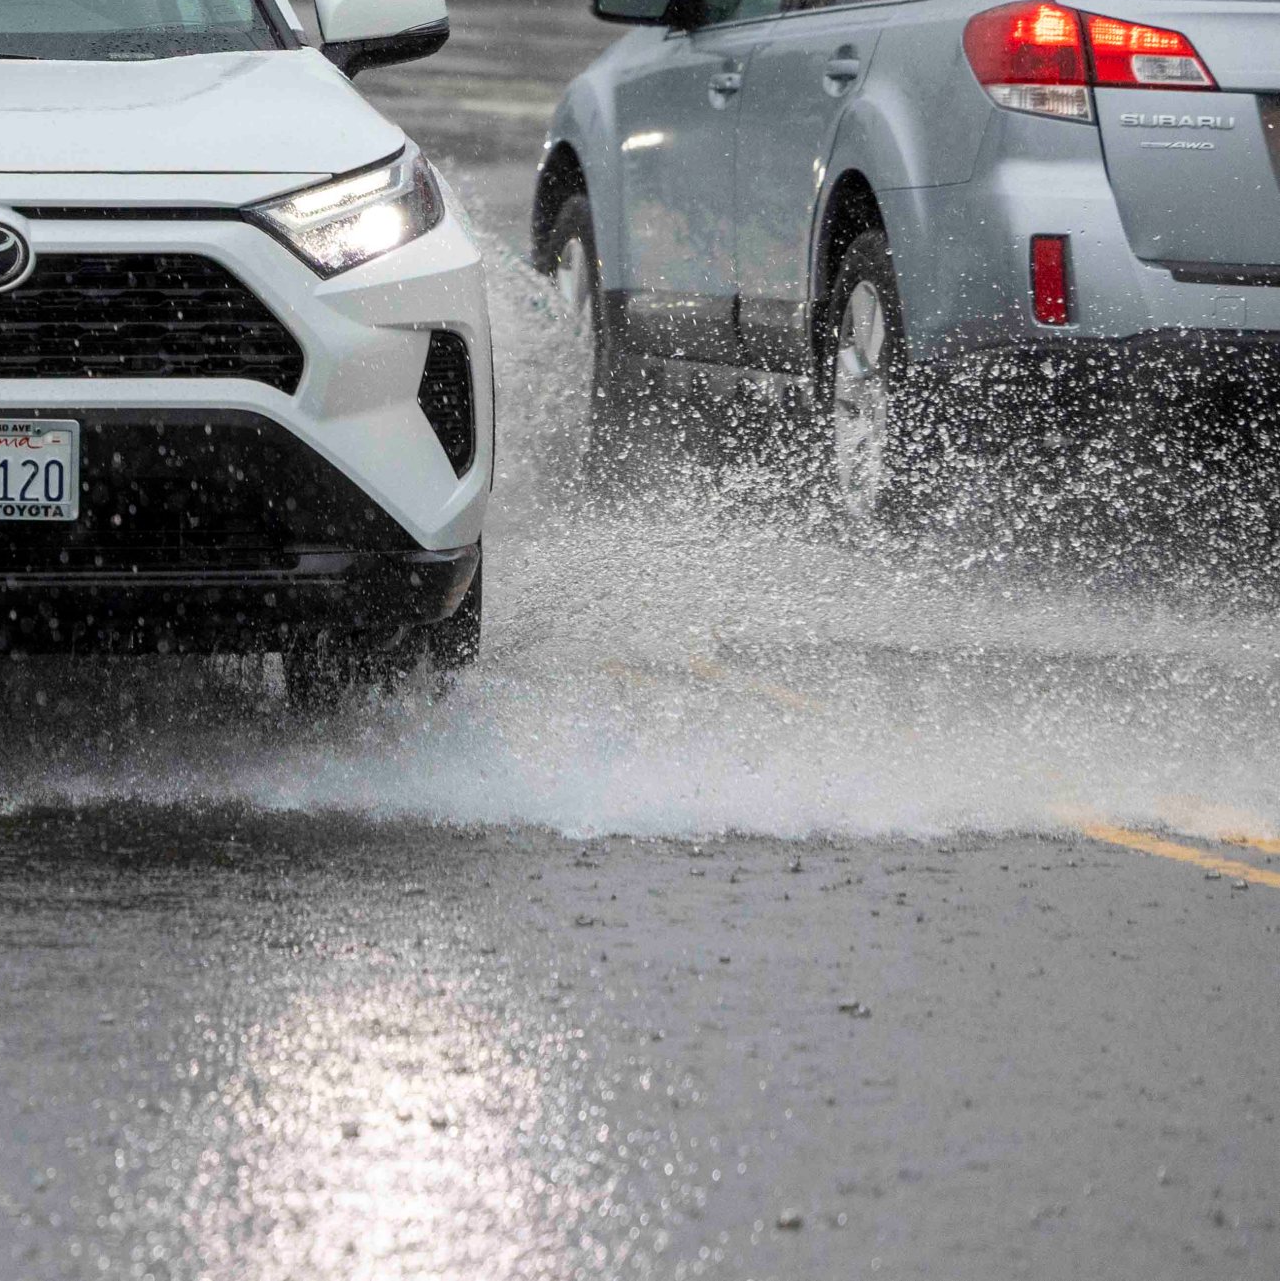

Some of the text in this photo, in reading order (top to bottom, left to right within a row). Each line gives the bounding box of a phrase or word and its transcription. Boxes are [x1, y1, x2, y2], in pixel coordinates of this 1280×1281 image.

[1120, 113, 1235, 130] SUBARU
[1168, 141, 1215, 150] AWD
[11, 423, 32, 433] AVE
